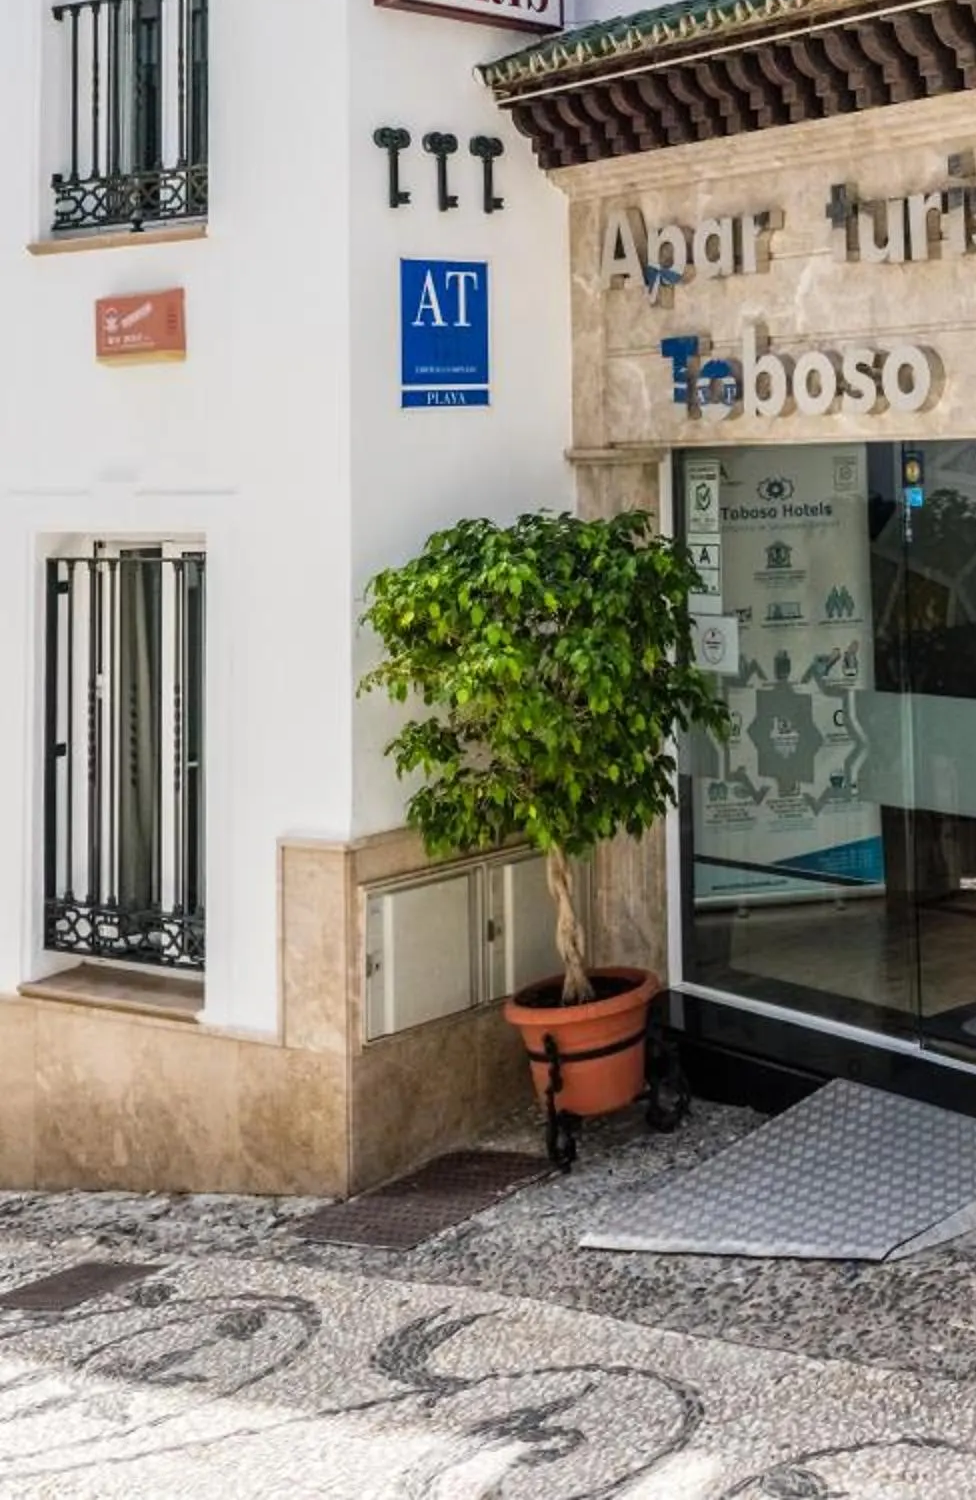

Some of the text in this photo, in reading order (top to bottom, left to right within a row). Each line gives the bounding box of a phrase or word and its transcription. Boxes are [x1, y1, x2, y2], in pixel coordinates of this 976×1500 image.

[601, 206, 784, 308] Apar
[412, 268, 479, 327] AT
[660, 314, 946, 422] Toboso
[427, 391, 467, 405] PLAYA
[783, 502, 833, 518] Hotels
